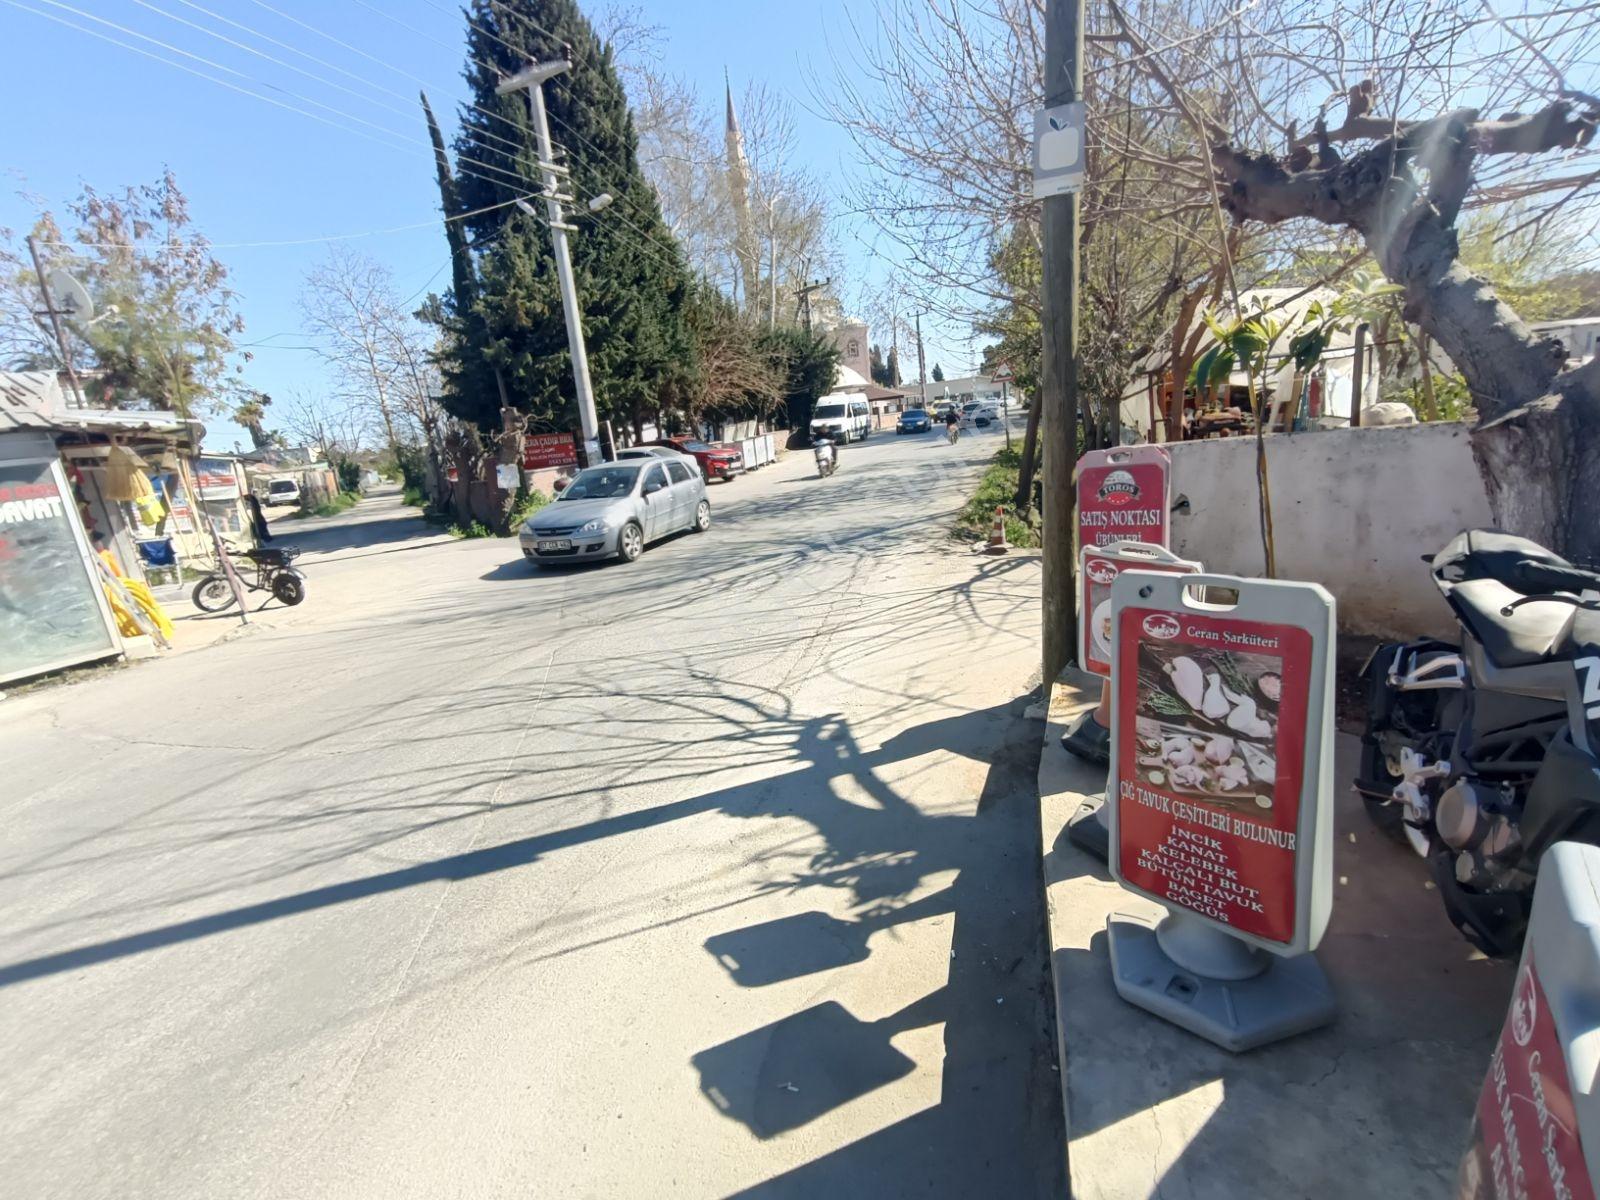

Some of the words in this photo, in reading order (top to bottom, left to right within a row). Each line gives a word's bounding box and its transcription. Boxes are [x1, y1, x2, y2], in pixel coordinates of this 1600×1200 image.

[1103, 484, 1135, 494] TOROS
[1081, 511, 1108, 529] SATIŞ
[1110, 509, 1160, 526] NOKTASI
[1187, 625, 1219, 640] Ceran
[1223, 631, 1279, 648] Şarküteri
[1120, 781, 1135, 800] ÇİĞ
[1137, 787, 1170, 814] TAVUK
[1172, 800, 1230, 833] ÇEŞİTLERİ
[1234, 819, 1296, 850] BULUNUR
[1167, 836, 1228, 863] KANAT
[1172, 824, 1222, 850] İNCİK
[1141, 849, 1213, 883] KALÇALI
[1220, 878, 1259, 898] BUT
[1158, 844, 1238, 880] KELEBEK
[1137, 858, 1196, 887] BÜTÜN
[1201, 883, 1264, 913] TAVUK
[1168, 880, 1227, 909] BAGET
